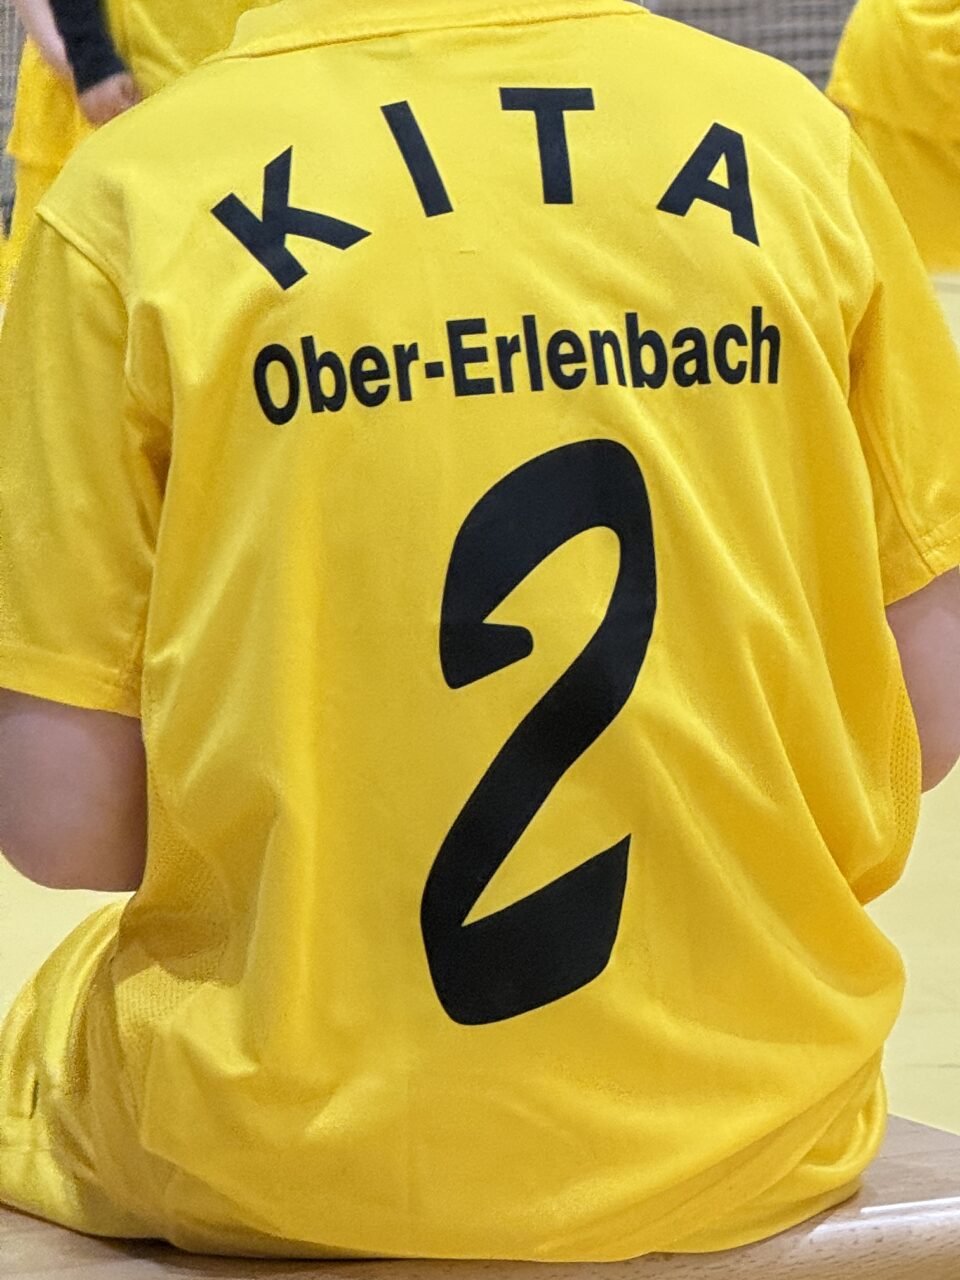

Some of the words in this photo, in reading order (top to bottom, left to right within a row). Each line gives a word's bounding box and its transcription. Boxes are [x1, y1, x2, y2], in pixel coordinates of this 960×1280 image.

[209, 87, 760, 291] KITA
[251, 305, 781, 426] Ober-Erlenbach
[419, 438, 657, 1026] 2
